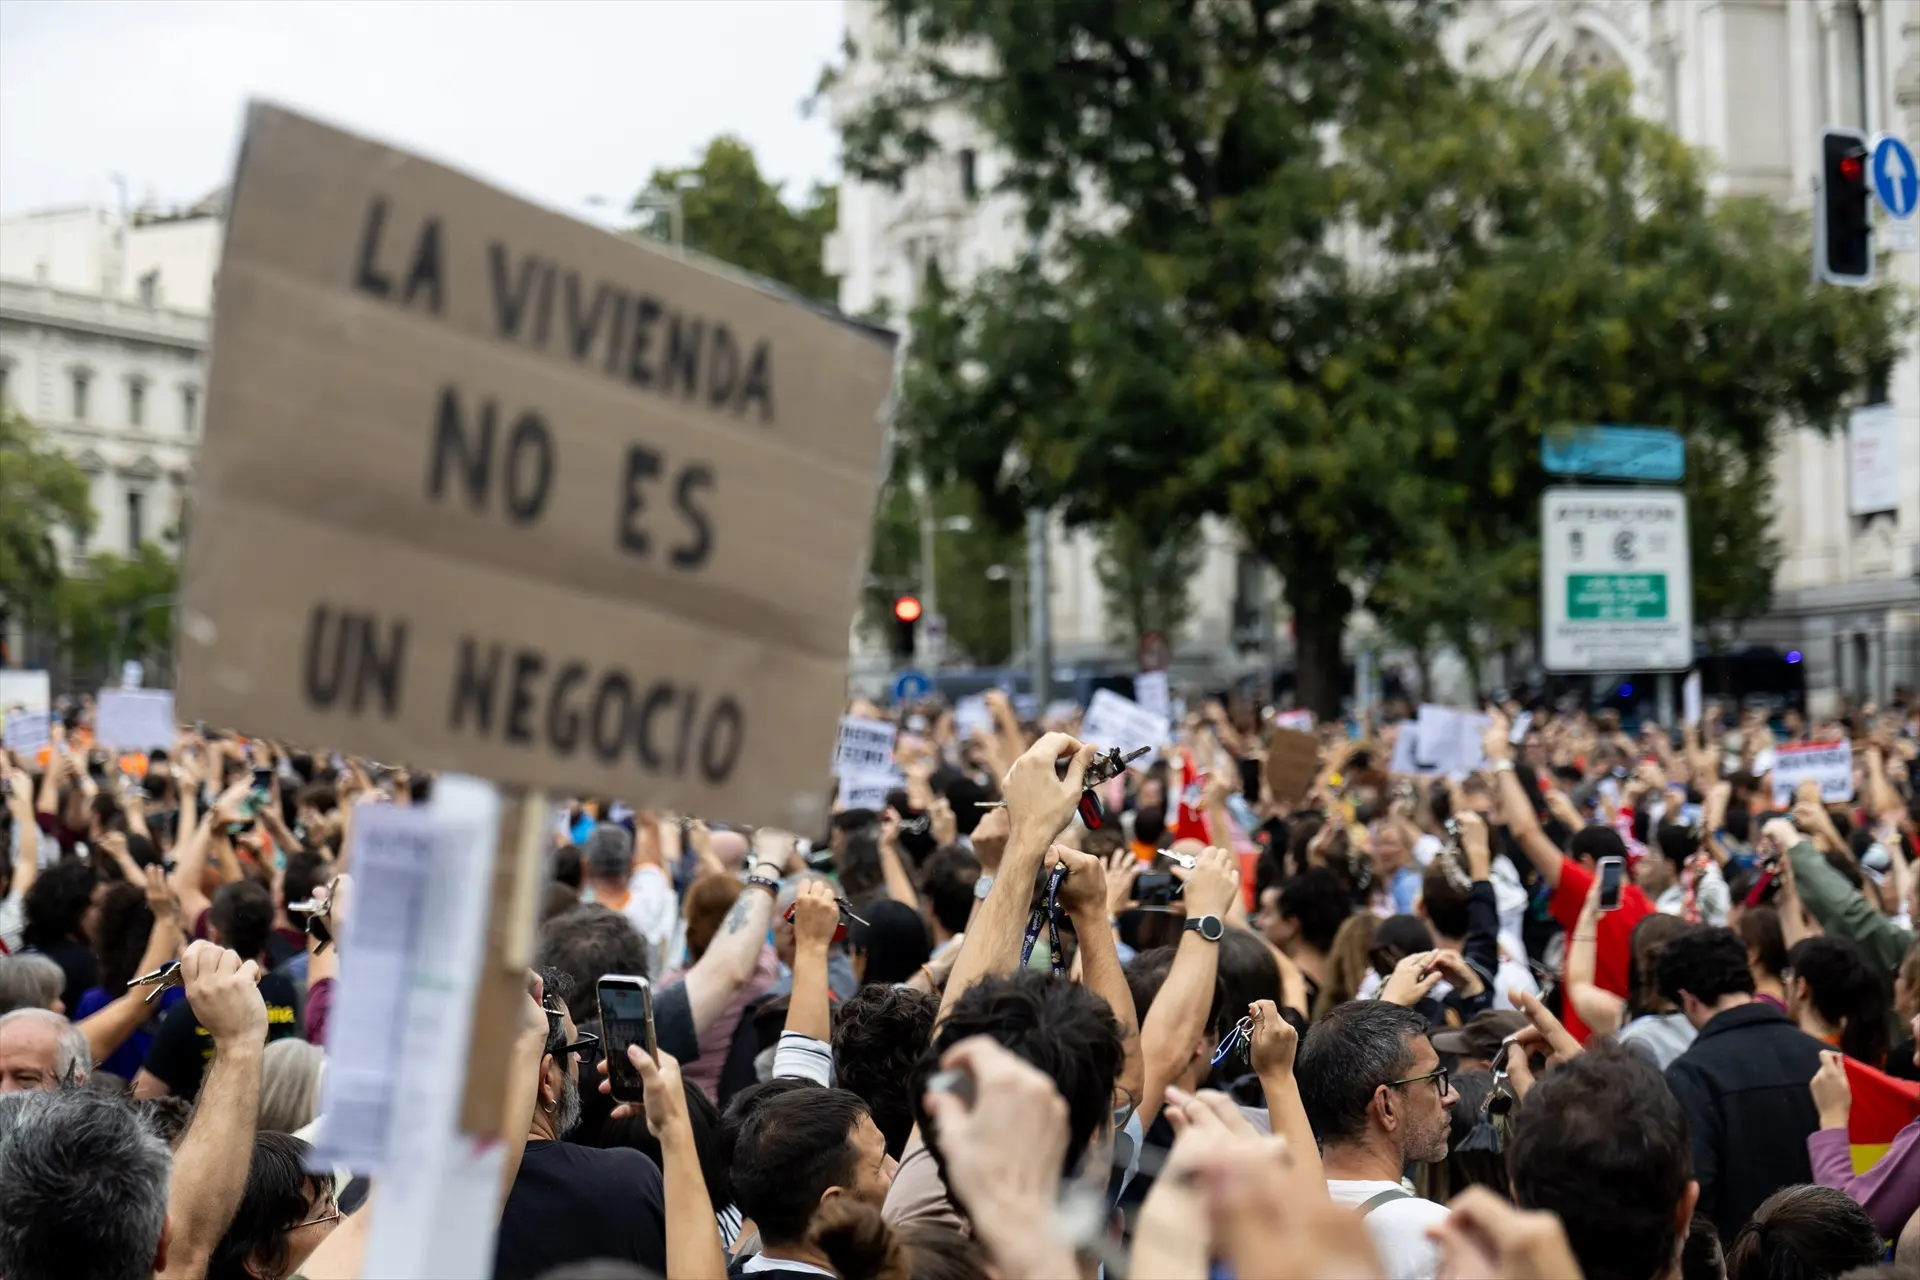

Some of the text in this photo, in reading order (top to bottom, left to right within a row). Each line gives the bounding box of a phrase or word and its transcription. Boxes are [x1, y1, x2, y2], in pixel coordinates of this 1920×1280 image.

[353, 197, 776, 424] LA VIVIENDA
[428, 384, 715, 572] NO ES
[305, 606, 745, 784] UN NEGOCIO
